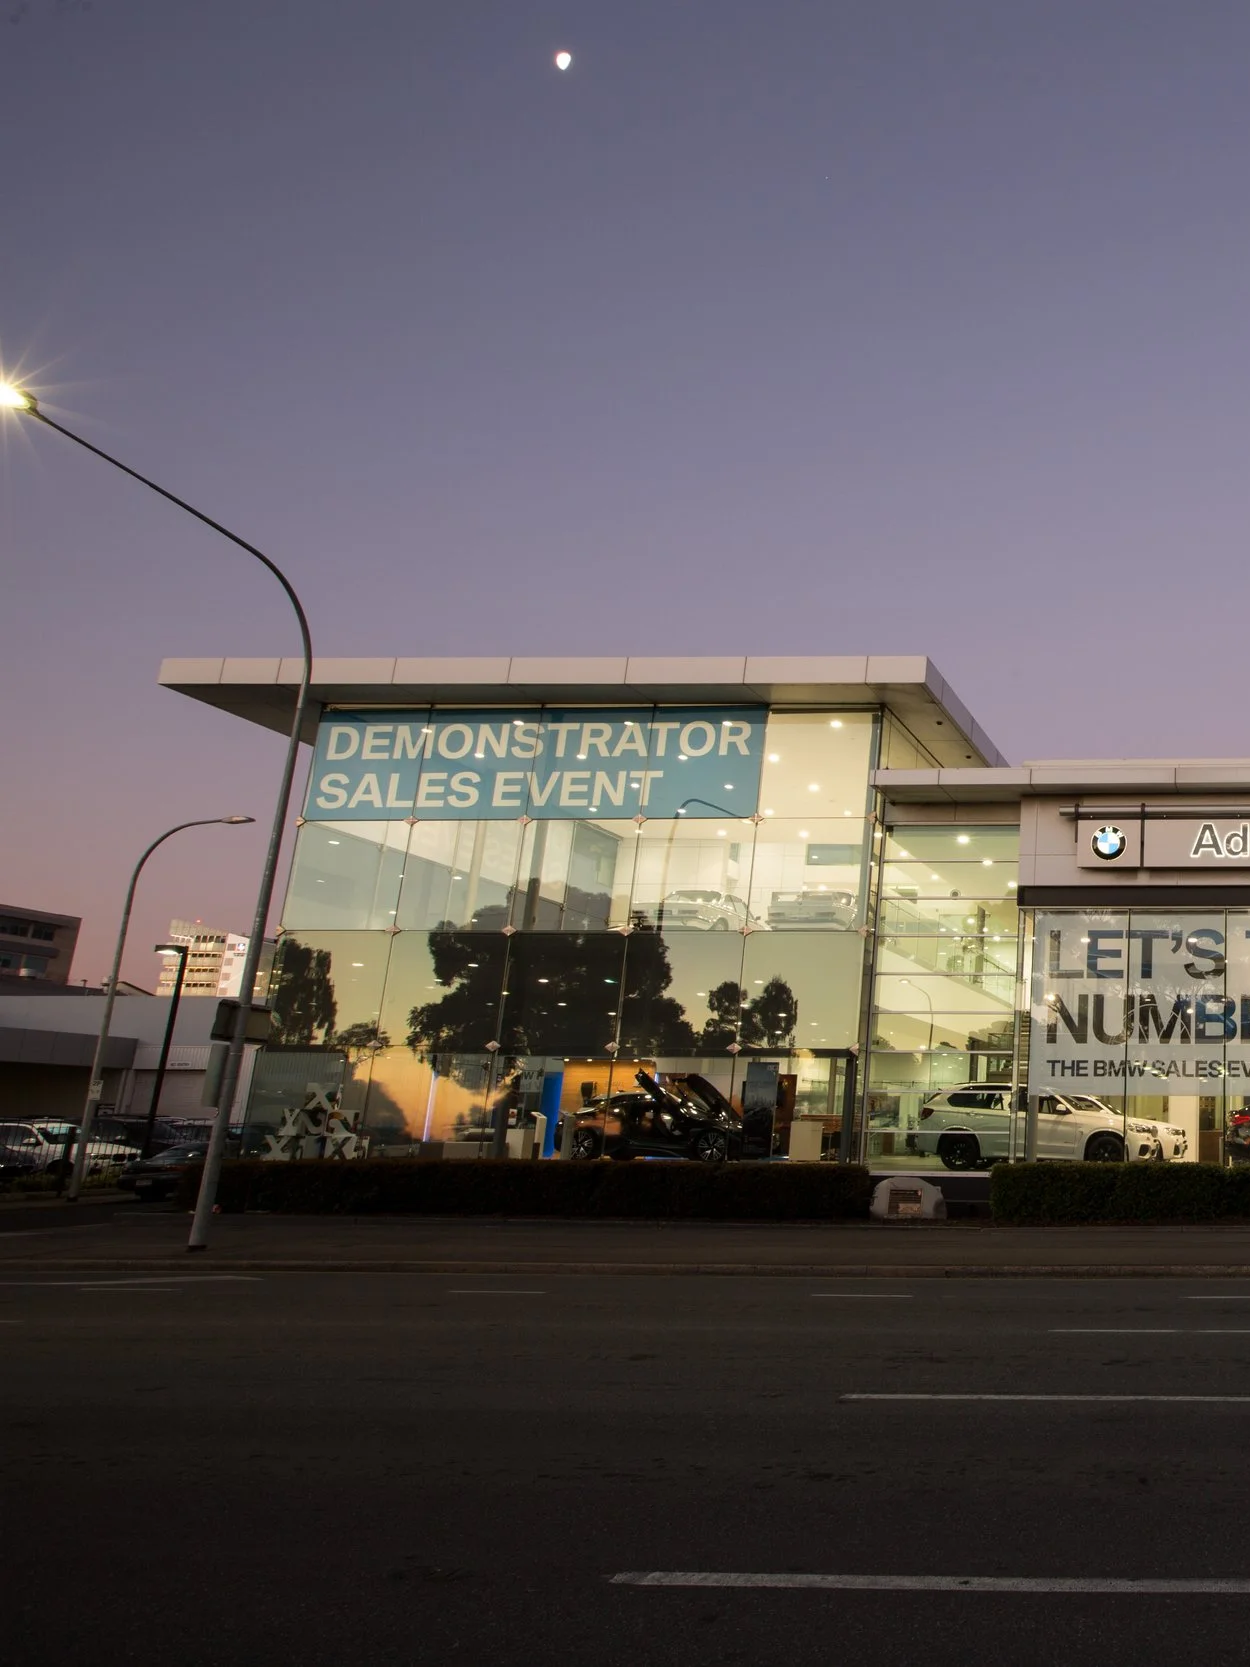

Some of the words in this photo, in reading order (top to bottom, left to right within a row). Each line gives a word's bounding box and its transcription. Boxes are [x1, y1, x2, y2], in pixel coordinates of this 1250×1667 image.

[326, 721, 752, 760] DEMONSTRATOR
[316, 771, 481, 810] SALES
[491, 770, 664, 808] EVENT
[1050, 929, 1226, 979] LET'S
[1046, 1060, 1089, 1077] THE
[1093, 1060, 1149, 1077] BMW
[1151, 1060, 1224, 1077] SALES
